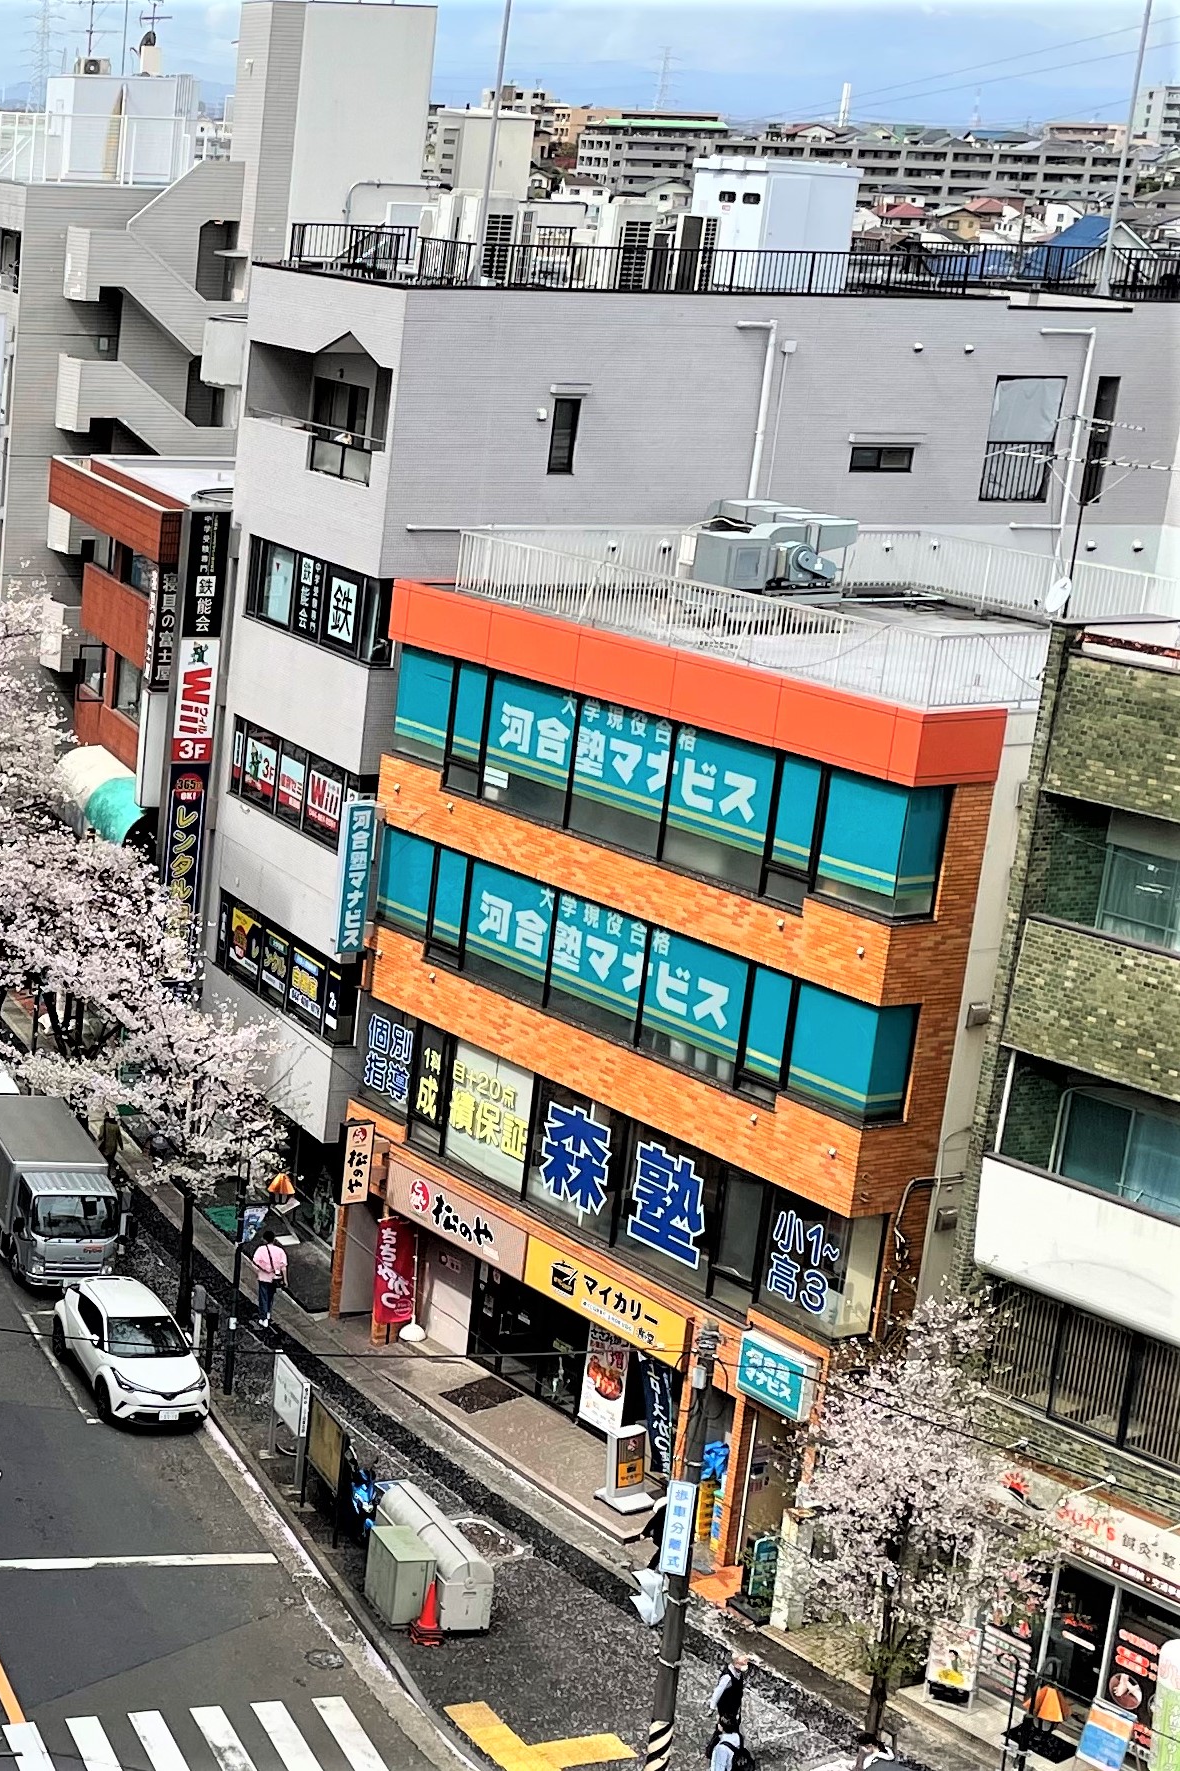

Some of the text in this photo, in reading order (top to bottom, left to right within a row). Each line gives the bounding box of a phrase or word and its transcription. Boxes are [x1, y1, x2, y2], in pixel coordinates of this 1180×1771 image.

[195, 578, 214, 632] 鉄能会
[331, 585, 353, 637] 鉄
[178, 667, 213, 735] Will
[561, 693, 697, 753] 大学現役合格
[178, 739, 207, 760] 3F
[499, 701, 758, 823] 河合塾マナビス
[341, 809, 372, 949] 河合塾マナビス
[539, 887, 671, 957] 大学現役合格
[478, 890, 731, 1030] 河合塾マナビス
[368, 1013, 414, 1065] 個別
[363, 1051, 411, 1104] 指導
[415, 1074, 529, 1163] 成績保証
[538, 1100, 706, 1271] 森塾
[431, 1192, 495, 1247] 松のや
[583, 1273, 659, 1326] マイカリー
[767, 1252, 830, 1315] 高3
